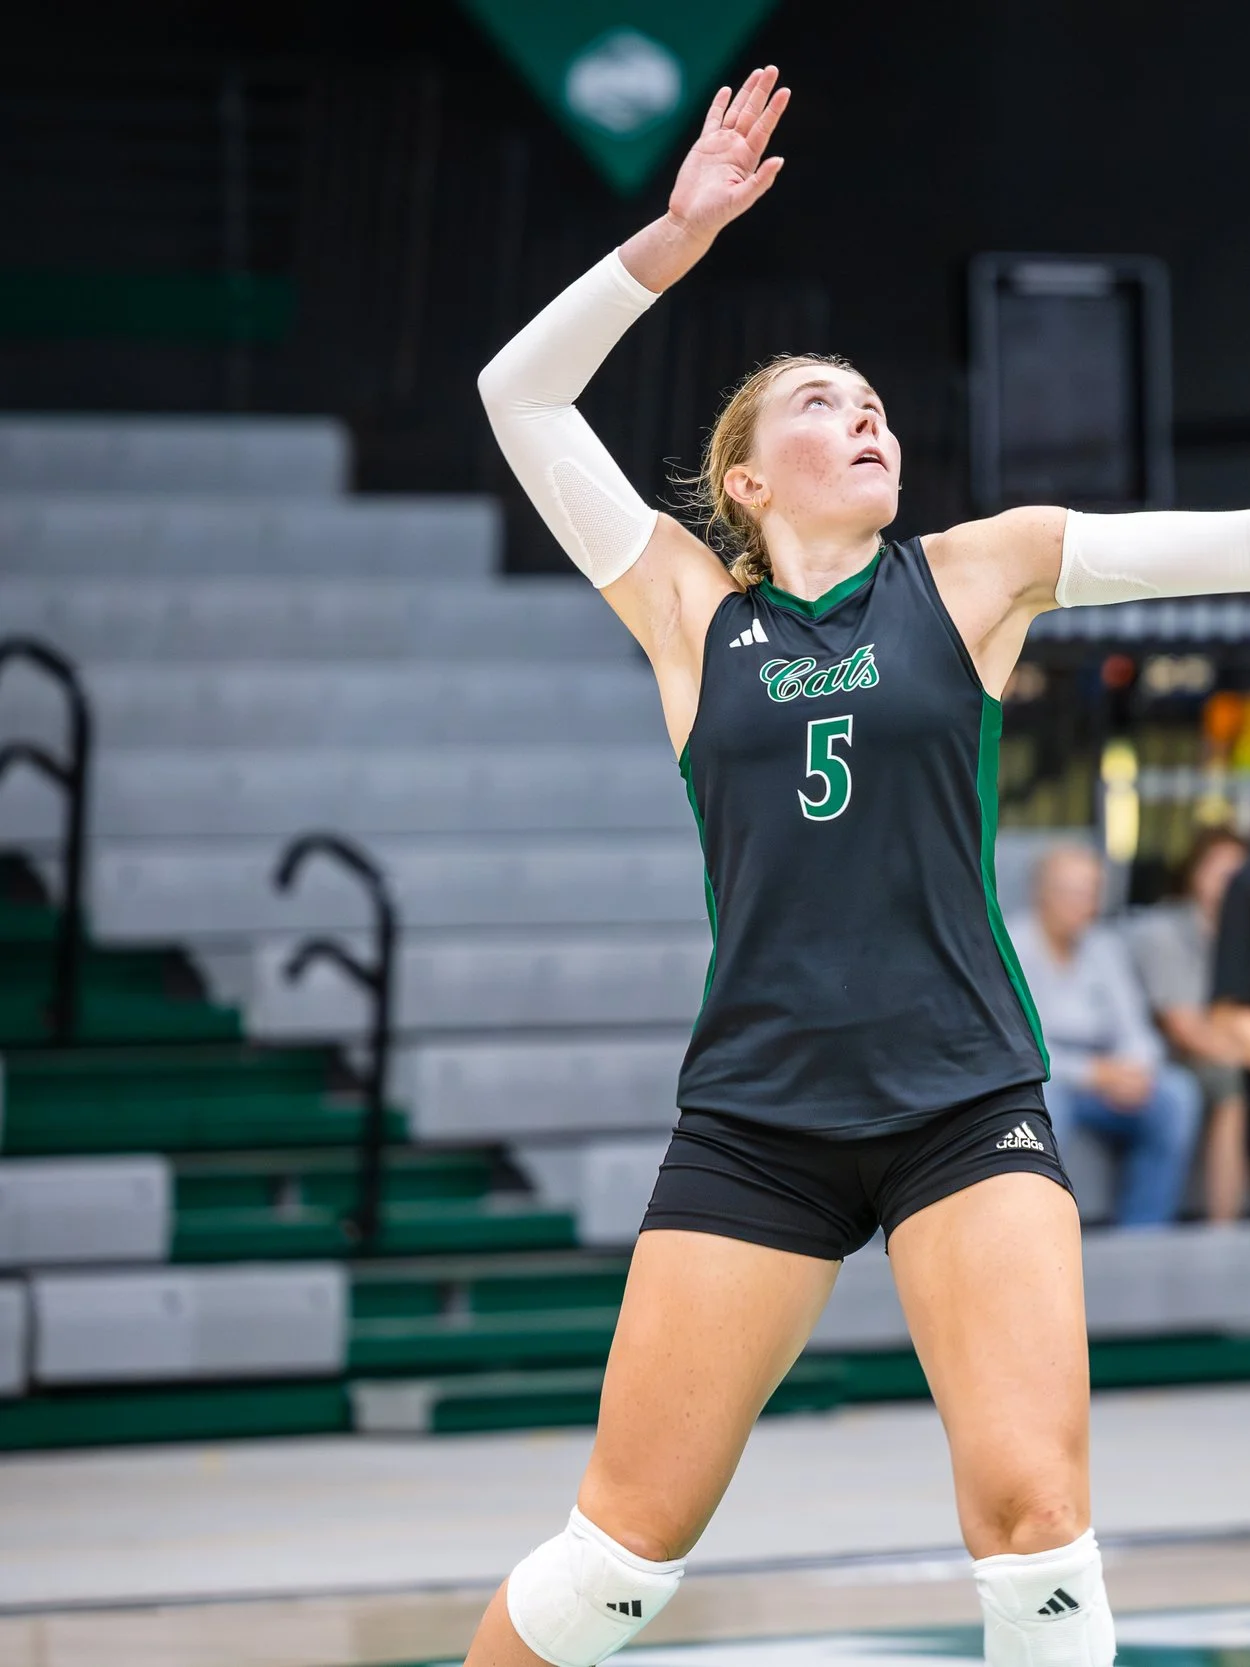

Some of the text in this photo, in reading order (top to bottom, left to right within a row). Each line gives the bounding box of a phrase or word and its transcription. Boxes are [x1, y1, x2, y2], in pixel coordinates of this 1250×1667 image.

[759, 643, 880, 702] Cats
[797, 714, 853, 821] 5
[996, 1137, 1045, 1151] adidas
